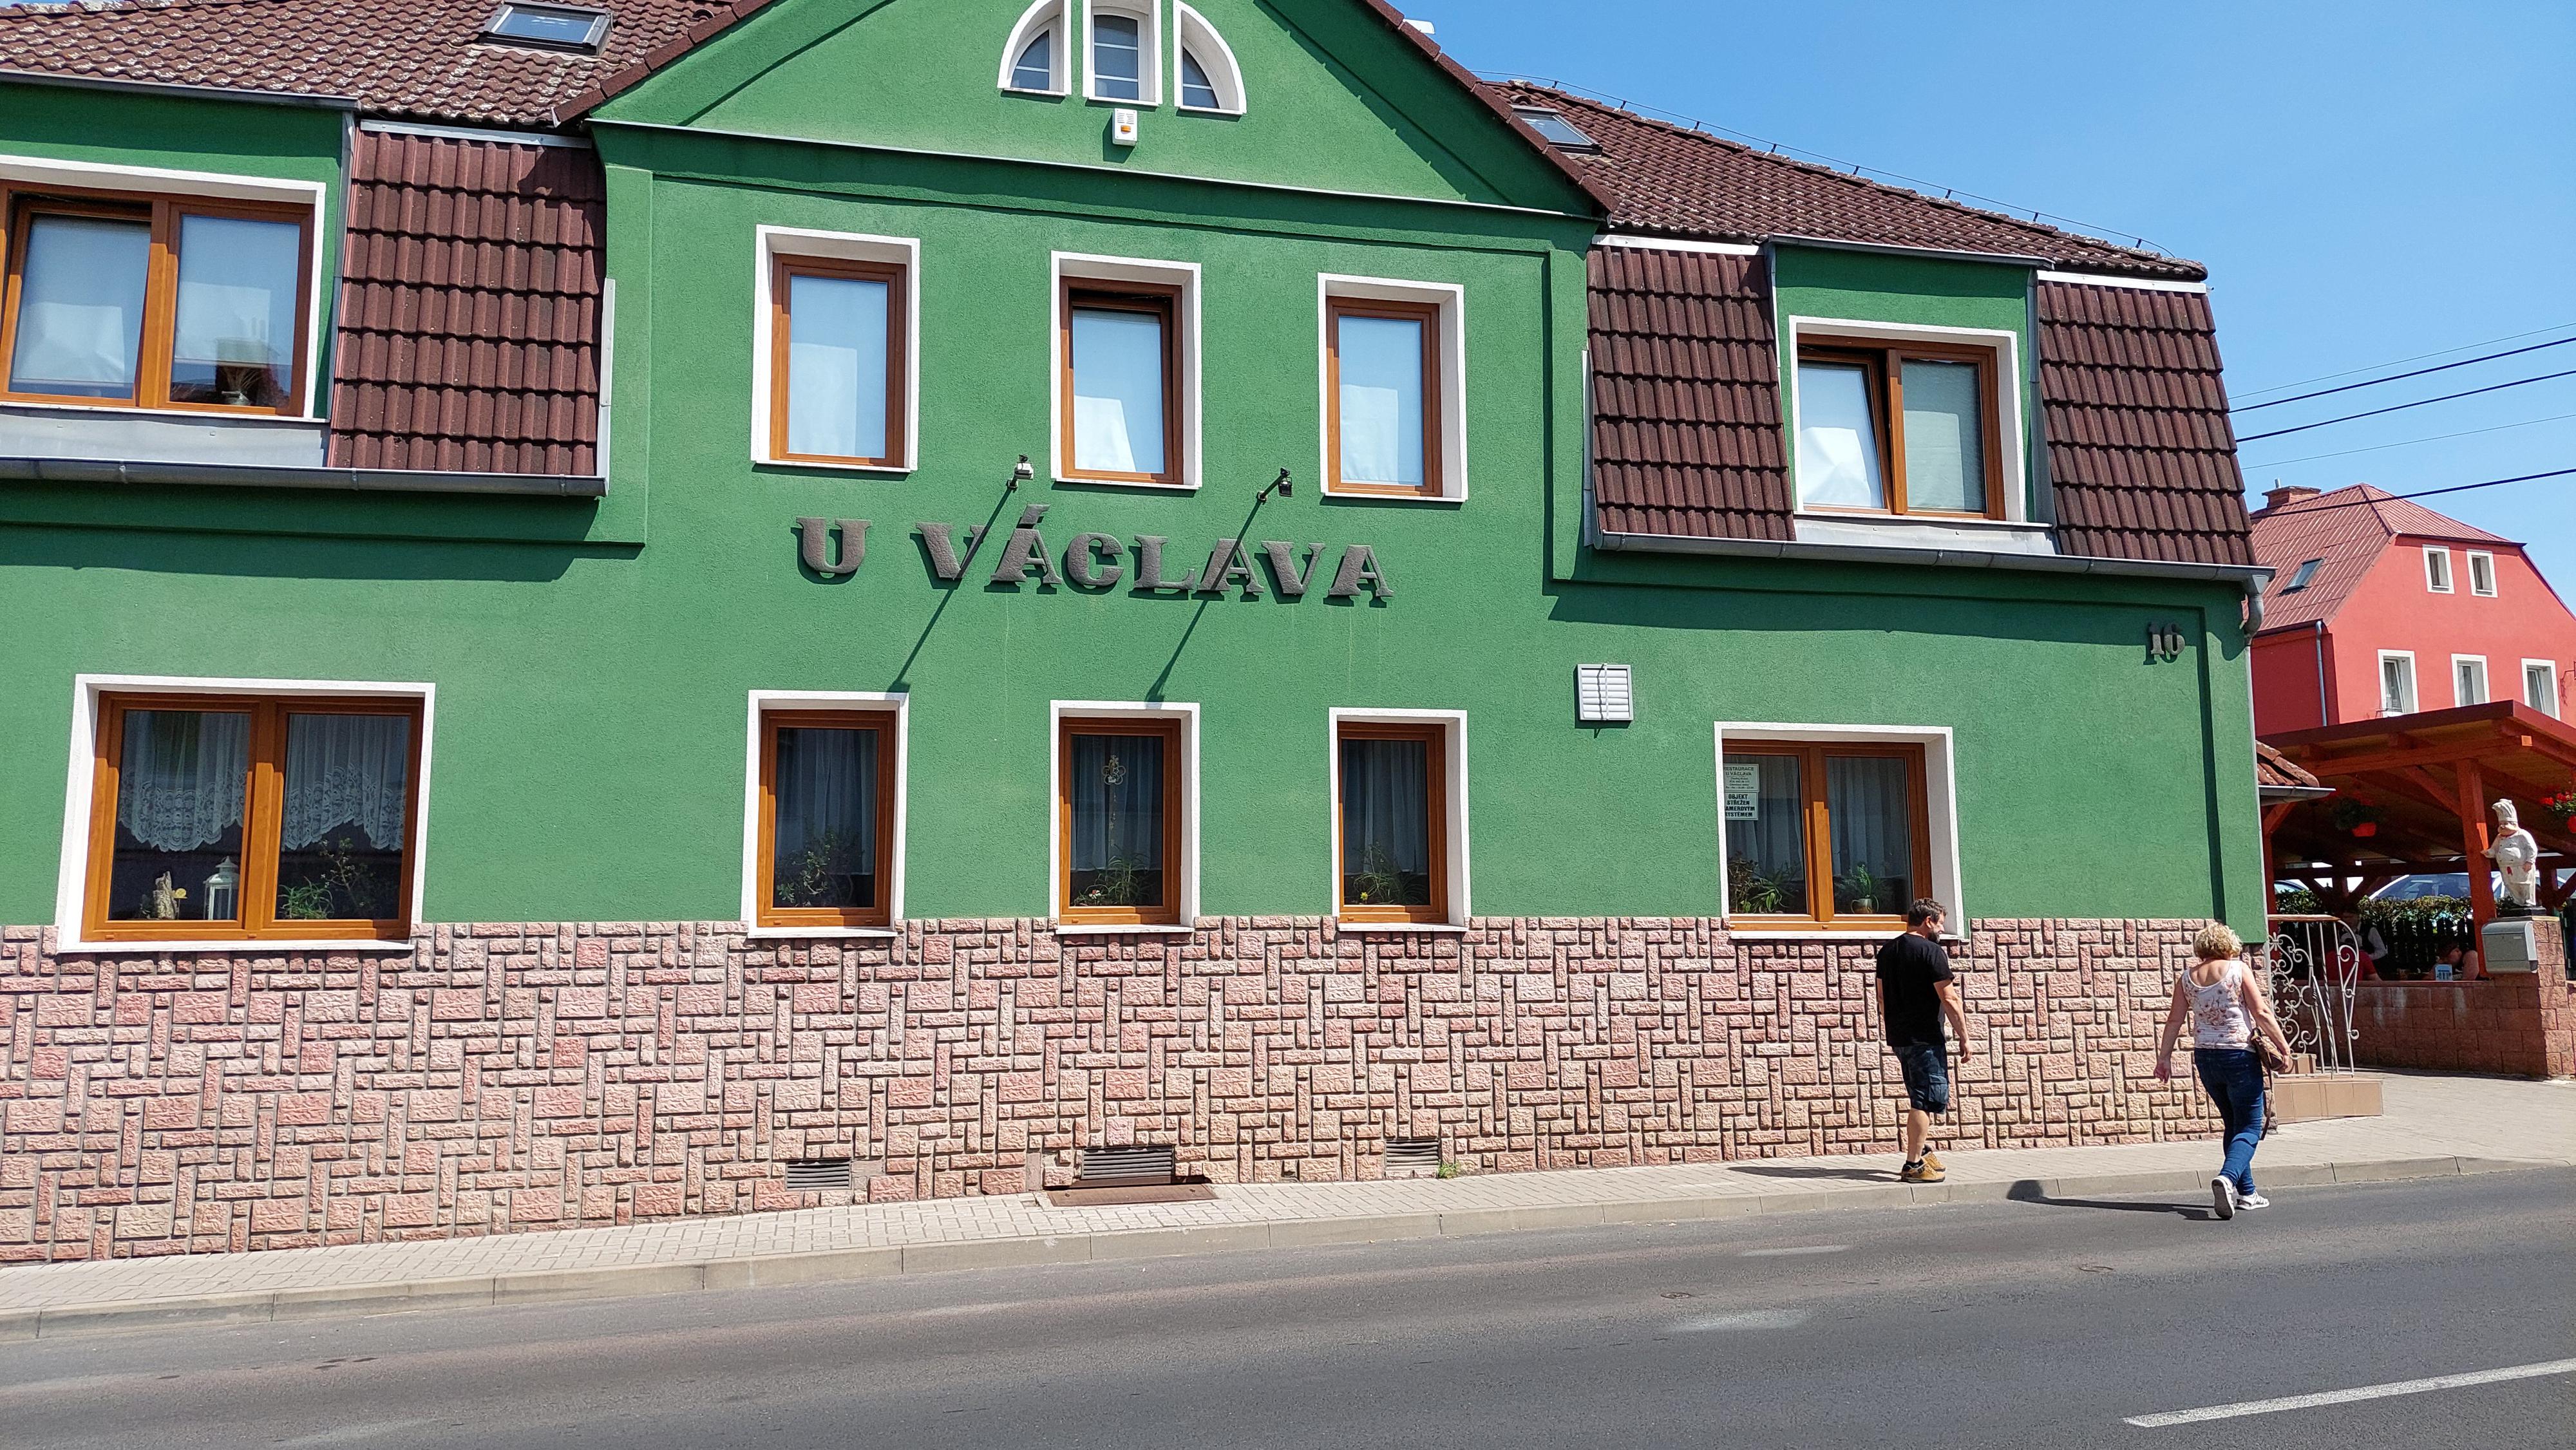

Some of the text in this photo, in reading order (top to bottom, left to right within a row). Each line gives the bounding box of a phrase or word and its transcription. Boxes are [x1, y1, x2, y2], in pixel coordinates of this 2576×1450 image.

[795, 504, 1394, 598] U VÁCLAVA
[2148, 621, 2185, 655] 16
